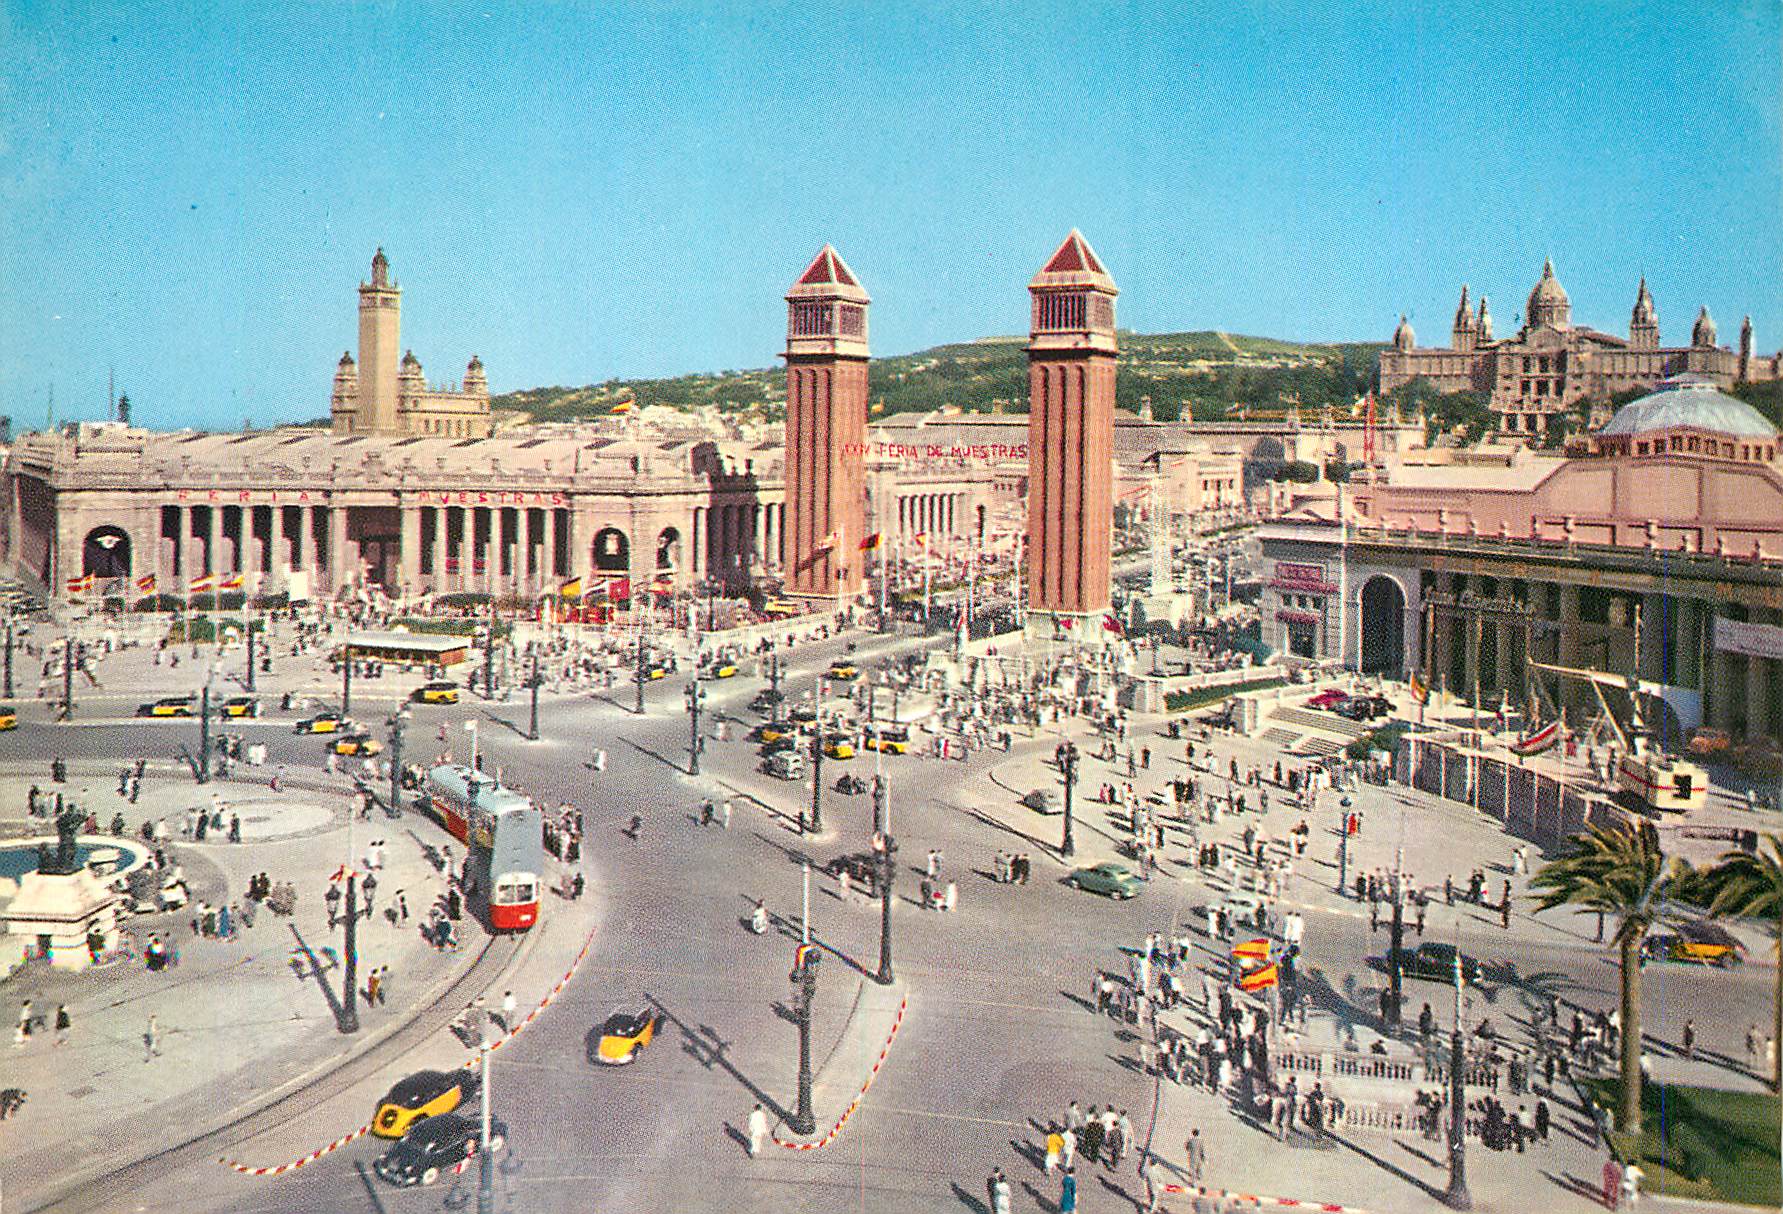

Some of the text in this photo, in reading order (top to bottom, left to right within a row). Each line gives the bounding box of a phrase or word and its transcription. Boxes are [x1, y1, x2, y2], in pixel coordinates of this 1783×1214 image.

[879, 443, 918, 458] FERIA
[927, 444, 944, 457] DE
[951, 444, 1028, 459] MUESTRAS
